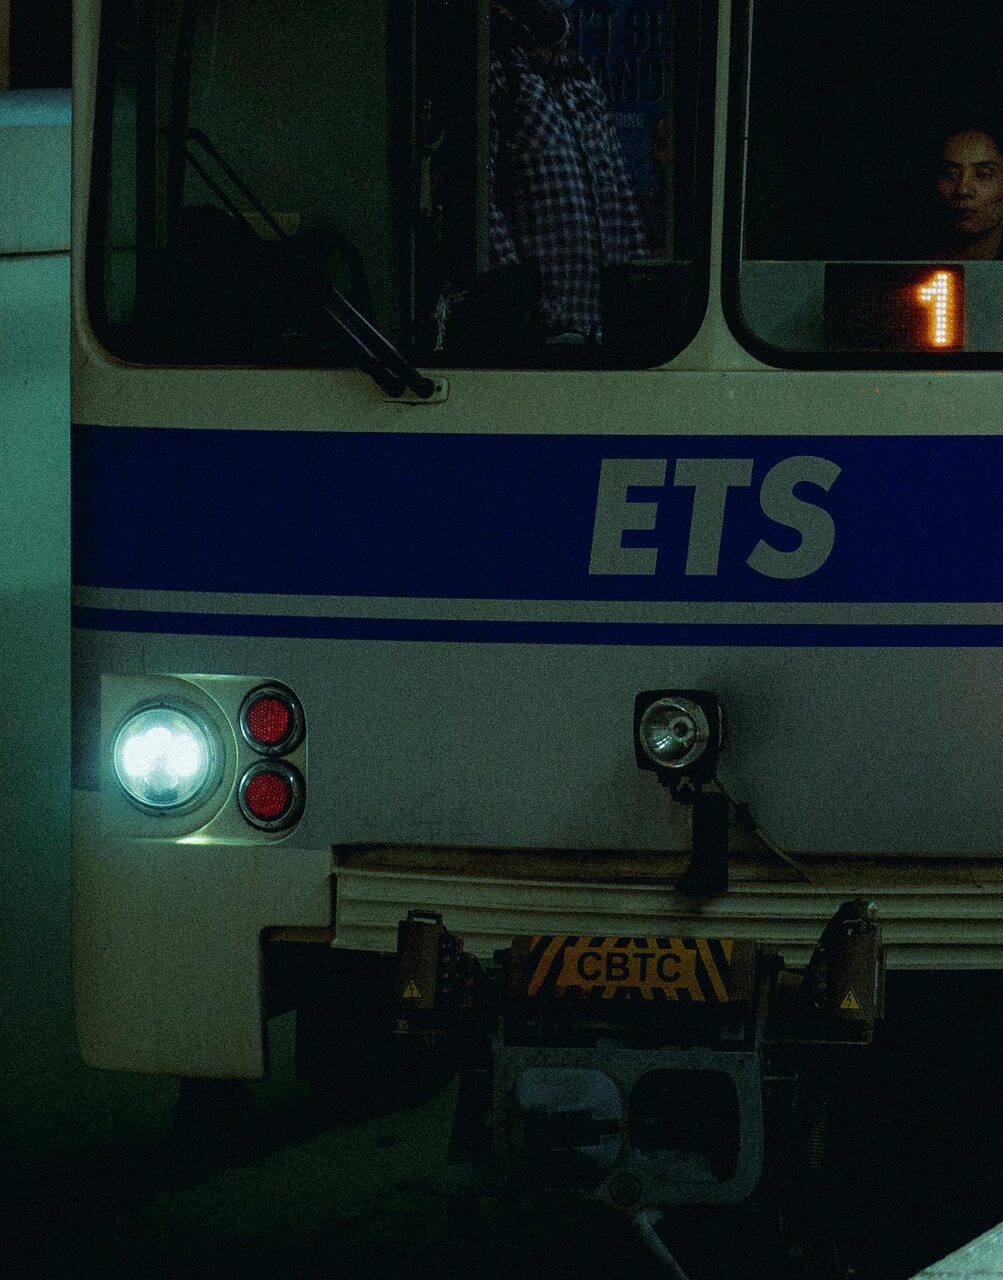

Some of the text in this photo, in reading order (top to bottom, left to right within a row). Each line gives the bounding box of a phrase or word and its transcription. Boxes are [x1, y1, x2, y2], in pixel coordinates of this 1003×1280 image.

[919, 271, 950, 346] 1
[588, 455, 843, 580] ETS
[578, 951, 682, 982] CBTC
